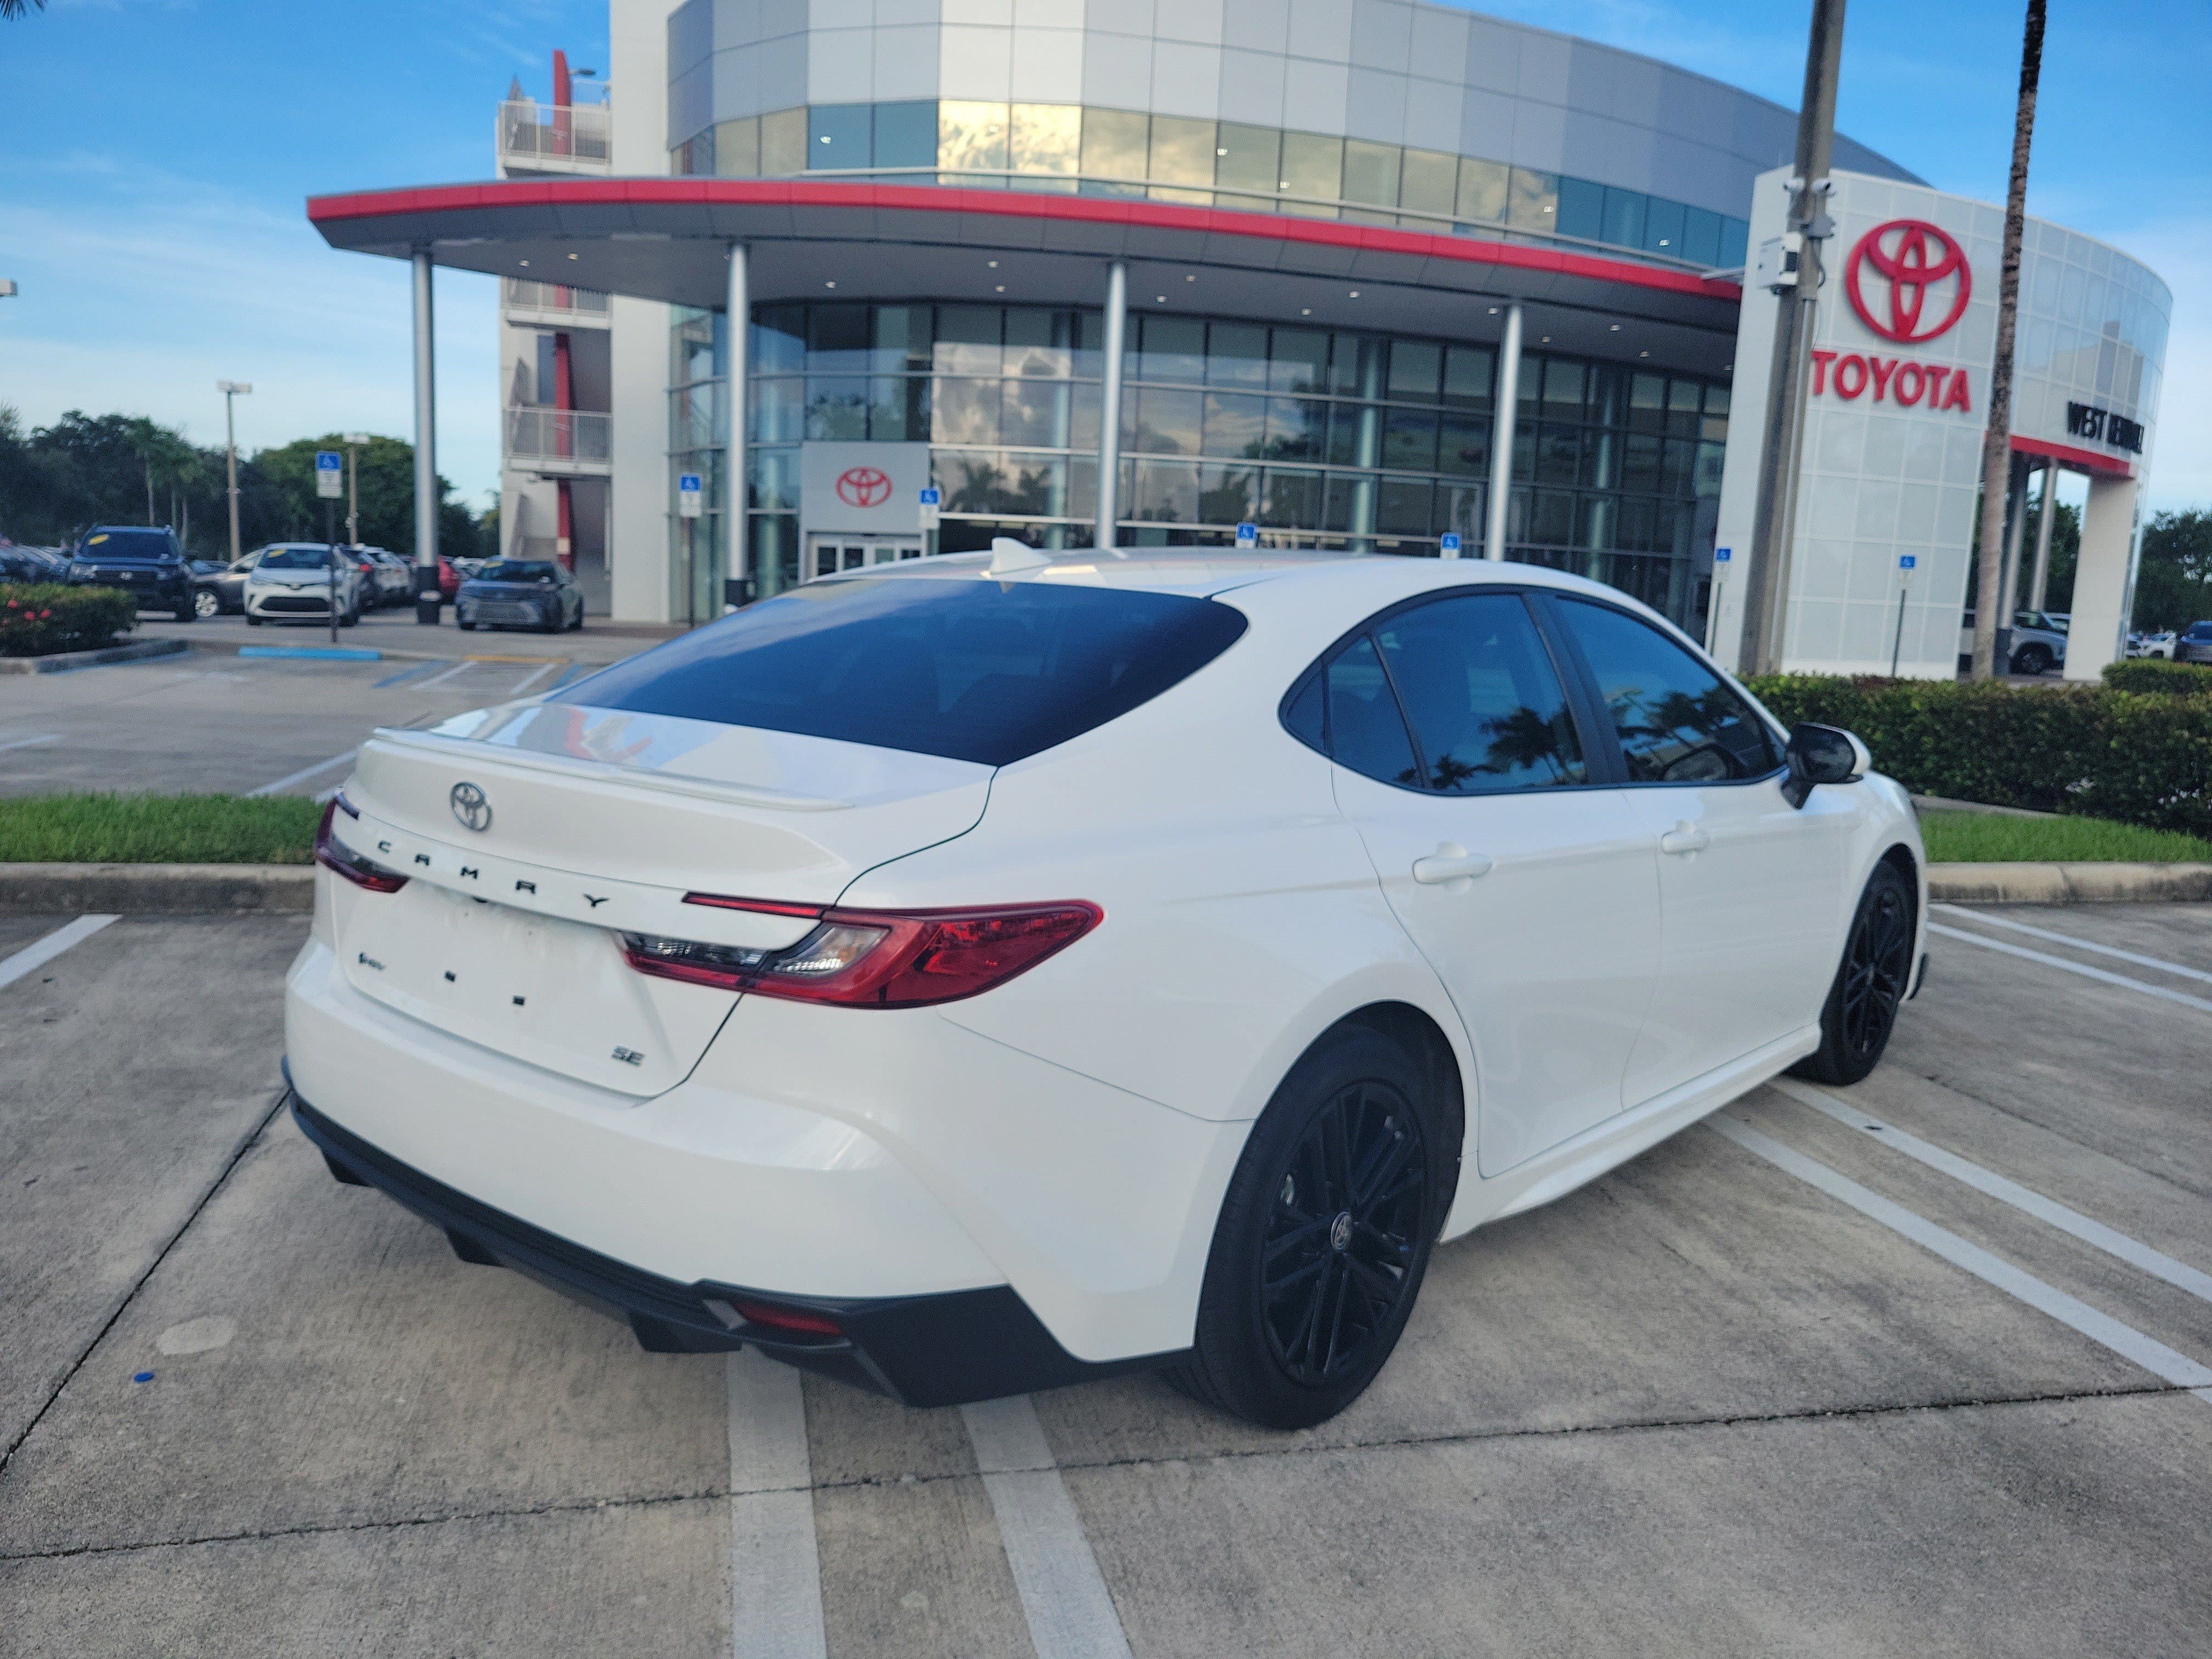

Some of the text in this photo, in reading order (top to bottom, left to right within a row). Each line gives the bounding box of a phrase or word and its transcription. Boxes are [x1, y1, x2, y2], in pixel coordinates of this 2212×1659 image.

[1812, 350, 1970, 412] TOYOTA
[2068, 401, 2107, 439] WEST
[378, 840, 610, 907] CAMRY
[612, 1046, 645, 1066] SE
